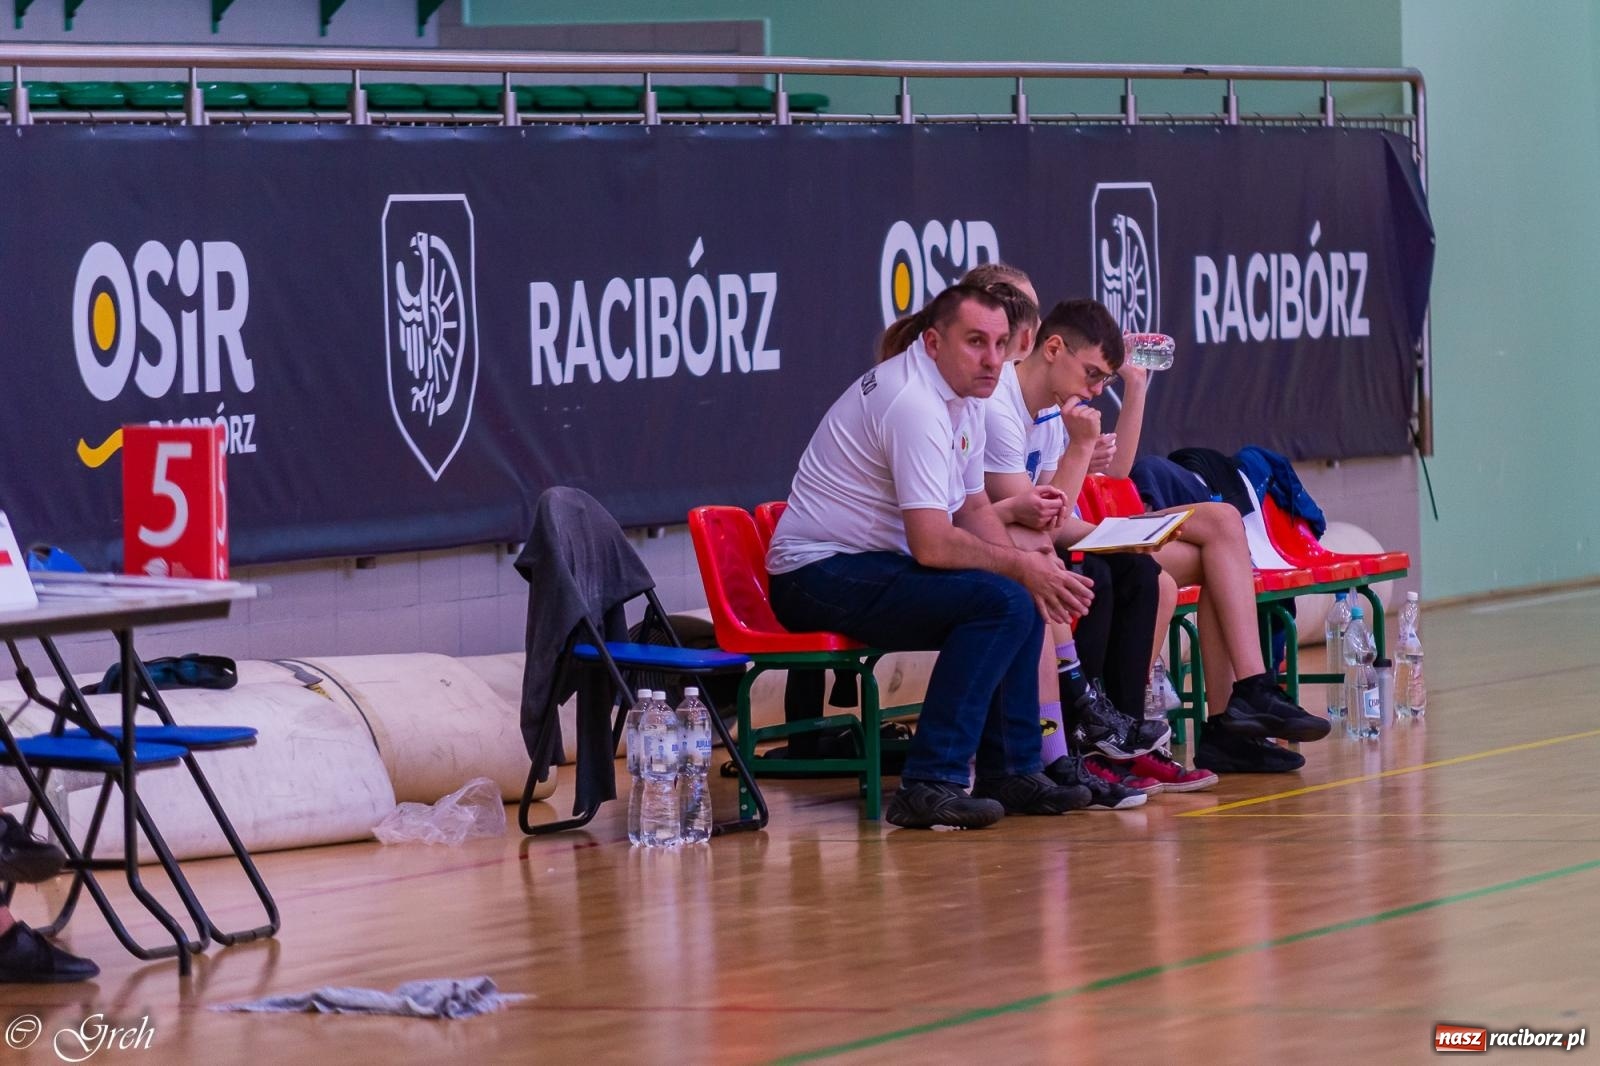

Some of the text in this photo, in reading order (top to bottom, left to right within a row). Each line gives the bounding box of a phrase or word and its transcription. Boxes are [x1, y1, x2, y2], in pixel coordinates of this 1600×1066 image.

[73, 240, 255, 401] OSiR
[529, 236, 781, 386] RACIBÓRZ
[1195, 219, 1370, 344] RACIBÓRZ
[138, 442, 192, 547] 5
